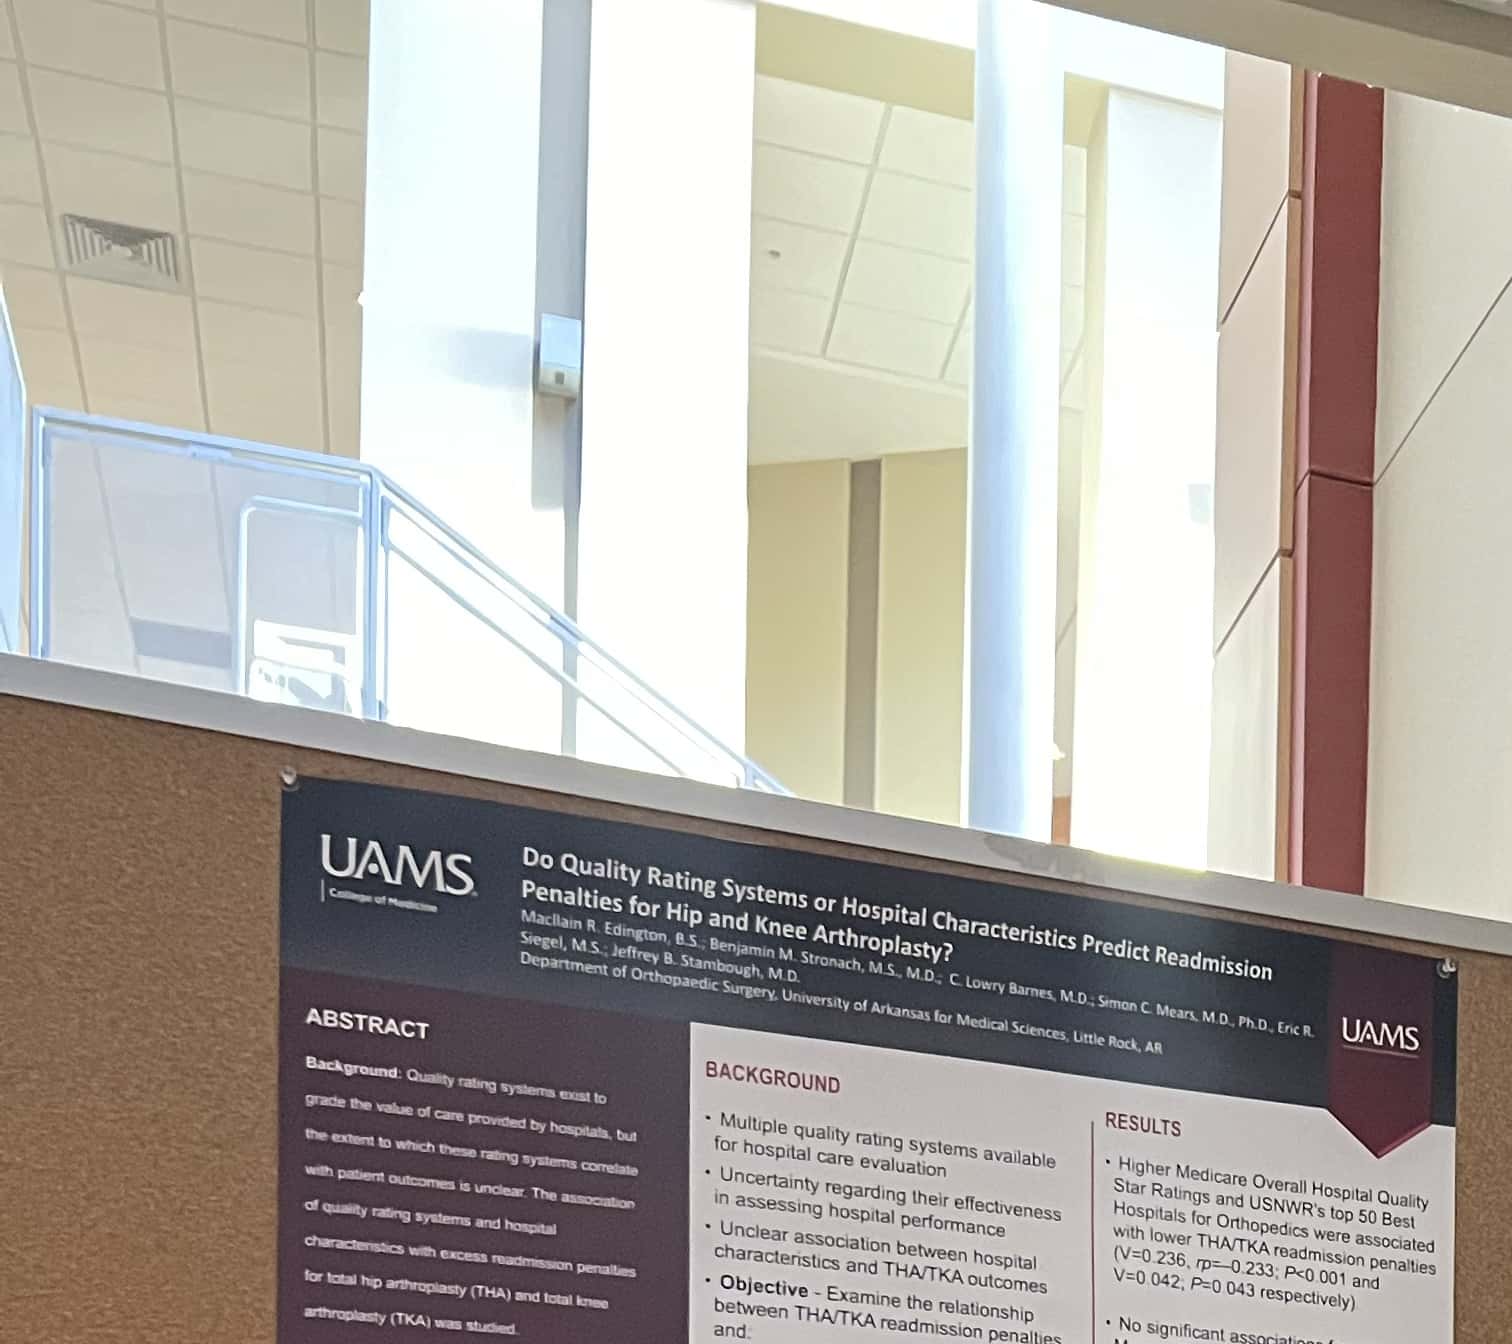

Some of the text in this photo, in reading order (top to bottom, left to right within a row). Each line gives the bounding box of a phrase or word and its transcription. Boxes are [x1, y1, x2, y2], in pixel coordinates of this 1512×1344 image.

[320, 833, 475, 896] UAMS
[521, 878, 953, 964] Penalties for Hip and Knee Arthroplasty?
[522, 845, 1272, 981] Do Quality Rating Systems or Hospital Characteristics Predict Readmission
[519, 930, 567, 952] Siegel,
[610, 943, 659, 965] Jeffrey
[679, 953, 764, 980] Stambough,
[767, 966, 800, 983] M.D.
[603, 920, 670, 945] Edington,
[709, 936, 775, 959] Benjamin
[799, 950, 865, 973] Stronach,
[965, 974, 1005, 995] Lowry
[1097, 994, 1138, 1012] Simon
[1277, 1020, 1300, 1036] Eric
[304, 1007, 429, 1039] ABSTRACT
[519, 950, 608, 976] Department
[611, 964, 628, 978] of
[630, 966, 720, 991] Orthopaedic
[781, 987, 850, 1012] University
[852, 998, 868, 1012] of
[870, 1000, 931, 1021] Arkansas
[933, 1008, 952, 1024] for
[956, 1012, 1008, 1032] Medical
[1010, 1020, 1069, 1042] Sciences,
[1072, 1029, 1105, 1046] Little
[1107, 1034, 1141, 1053] Rock,
[1144, 1040, 1162, 1054] AR
[1341, 1016, 1420, 1051] UAMS
[304, 1054, 607, 1104] Background: Quality rating systems exist to
[705, 1060, 840, 1094] BACKGROUND
[720, 1111, 1056, 1169] Multiple quality rating systems available
[1104, 1111, 1181, 1137] RESULTS
[713, 1134, 946, 1178] for hospital care evaluation
[720, 1165, 1062, 1221] Uncertainty regarding their effectiveness
[1118, 1155, 1429, 1213] Higher Medicare Overall Hospital Quality
[1113, 1199, 1435, 1253] Hospitals for Orthopedics were associated
